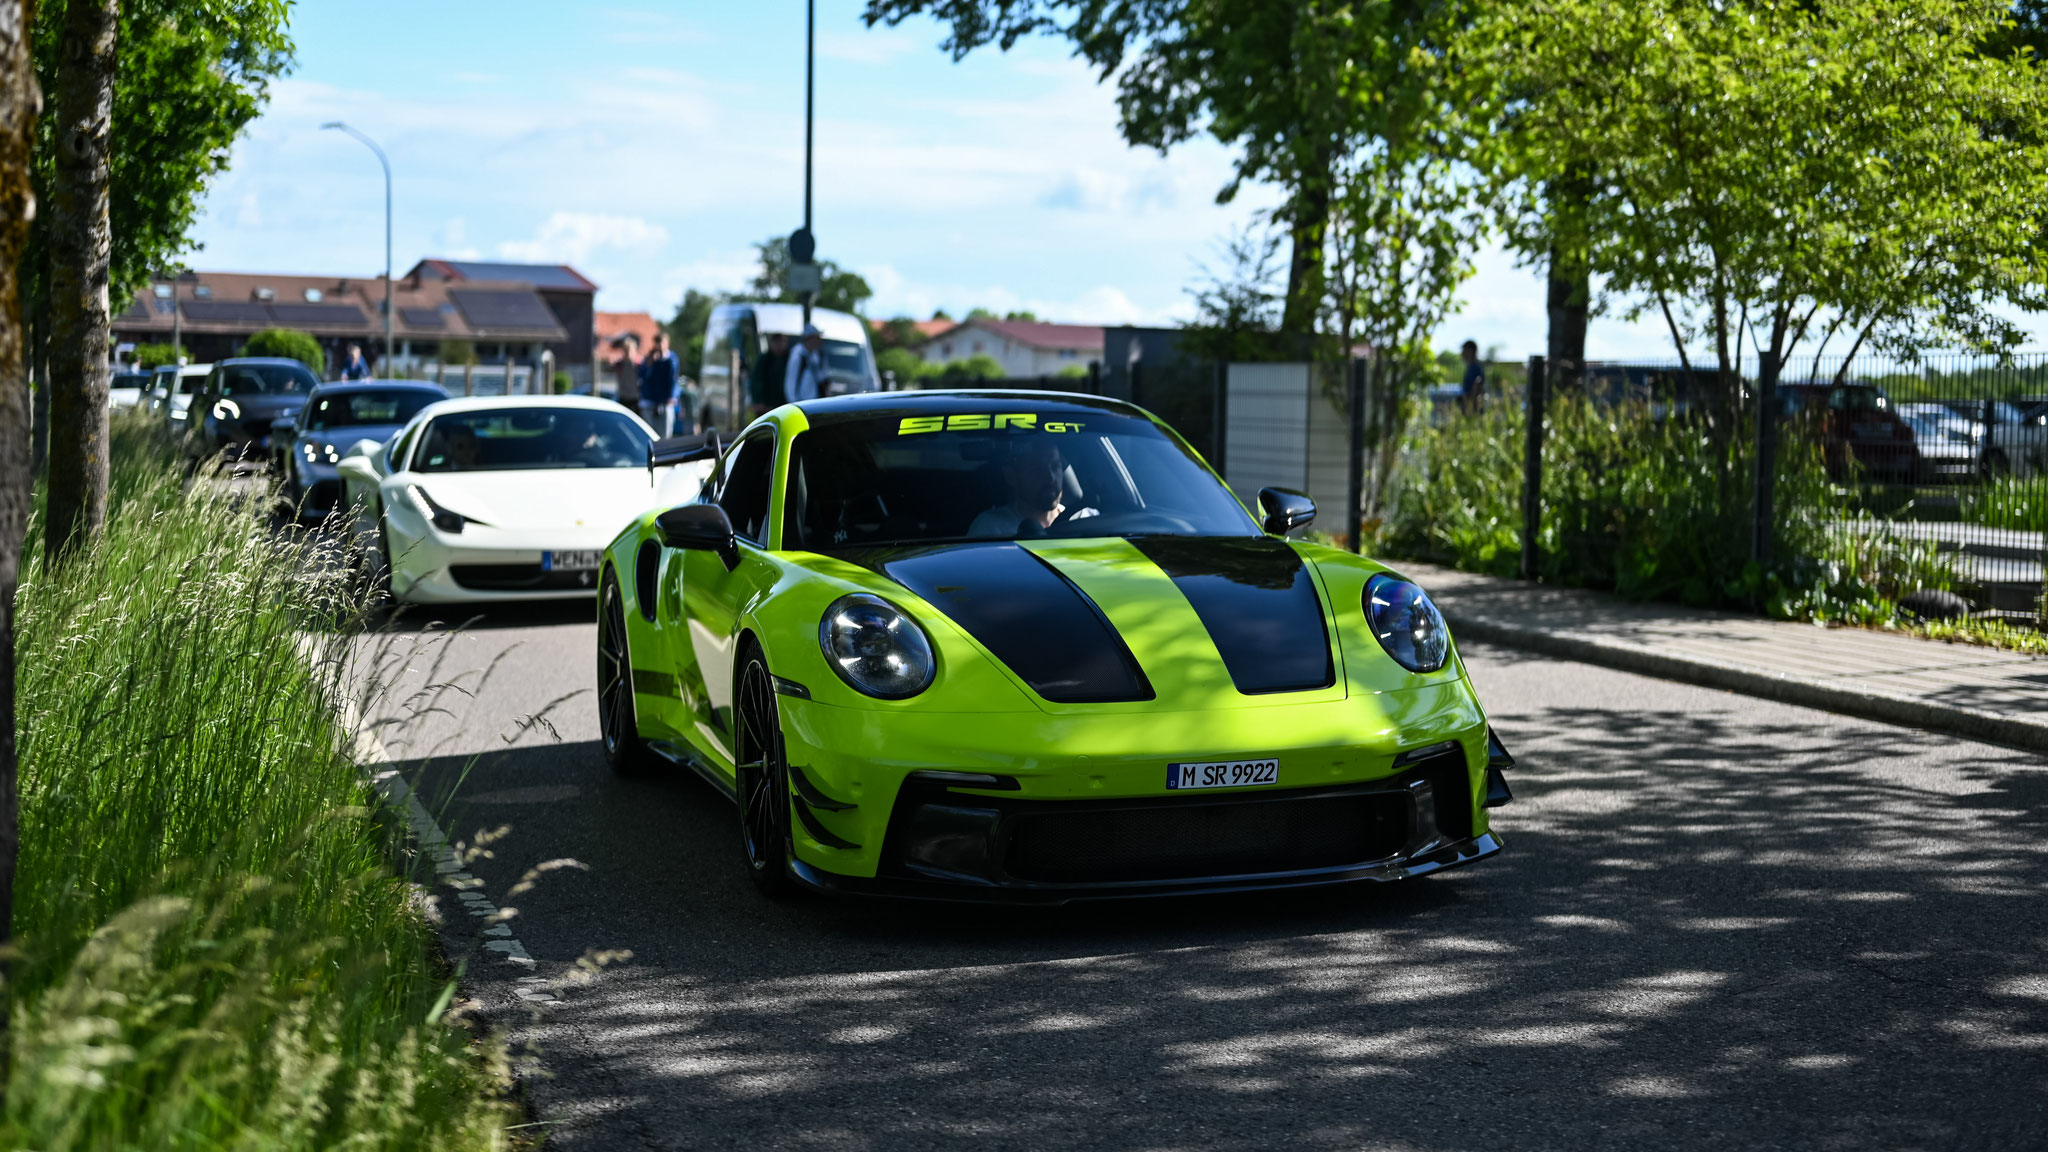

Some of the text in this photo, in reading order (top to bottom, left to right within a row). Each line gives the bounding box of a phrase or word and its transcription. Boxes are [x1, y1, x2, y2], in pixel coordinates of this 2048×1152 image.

[898, 413, 1086, 435] SSR GT
[1182, 766, 1196, 786] M
[1202, 765, 1228, 785] SR
[1232, 762, 1275, 784] 9922
